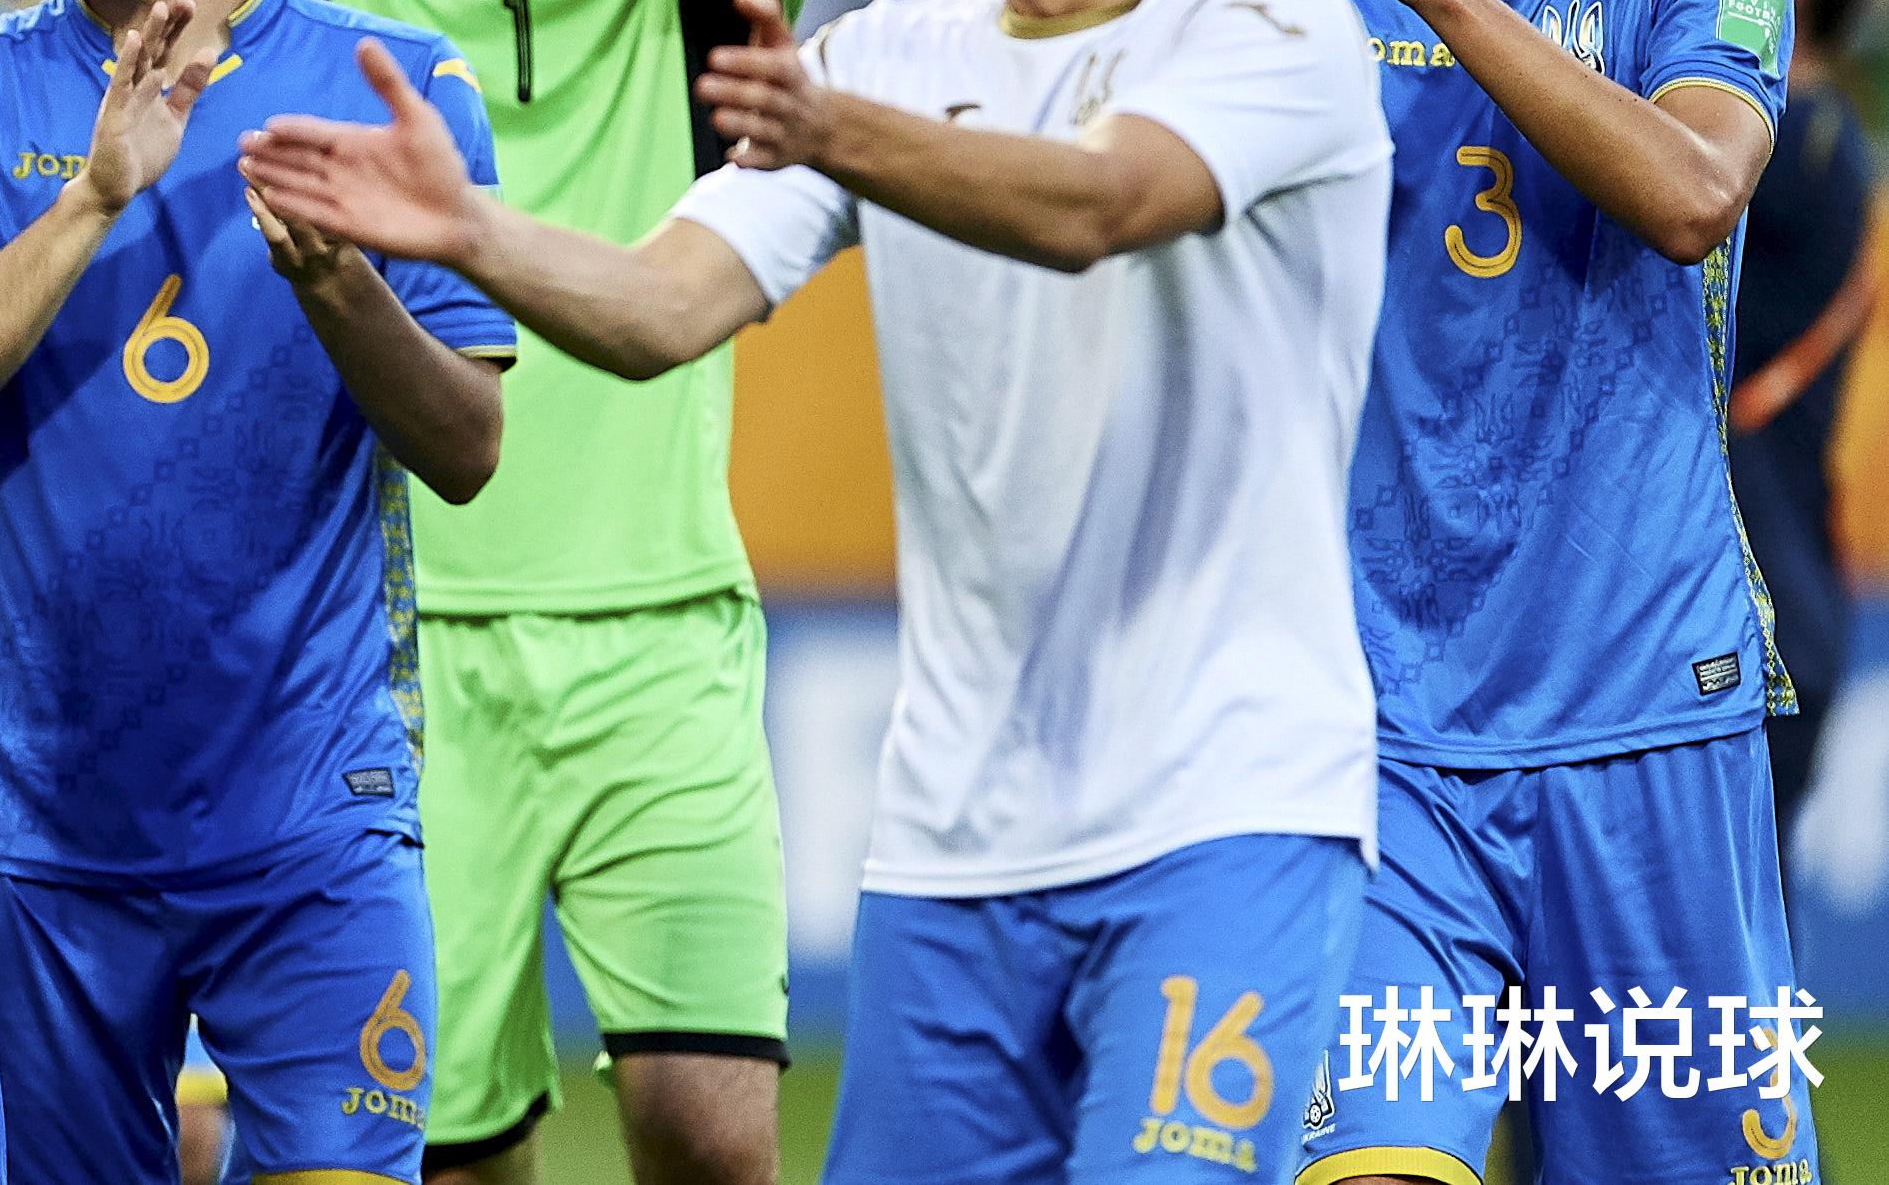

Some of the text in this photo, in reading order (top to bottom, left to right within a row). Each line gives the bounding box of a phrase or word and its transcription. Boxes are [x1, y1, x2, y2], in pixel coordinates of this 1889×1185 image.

[1444, 145, 1523, 278] 3
[123, 274, 209, 403] 6
[359, 968, 428, 1092] 6
[1149, 975, 1275, 1130] 16
